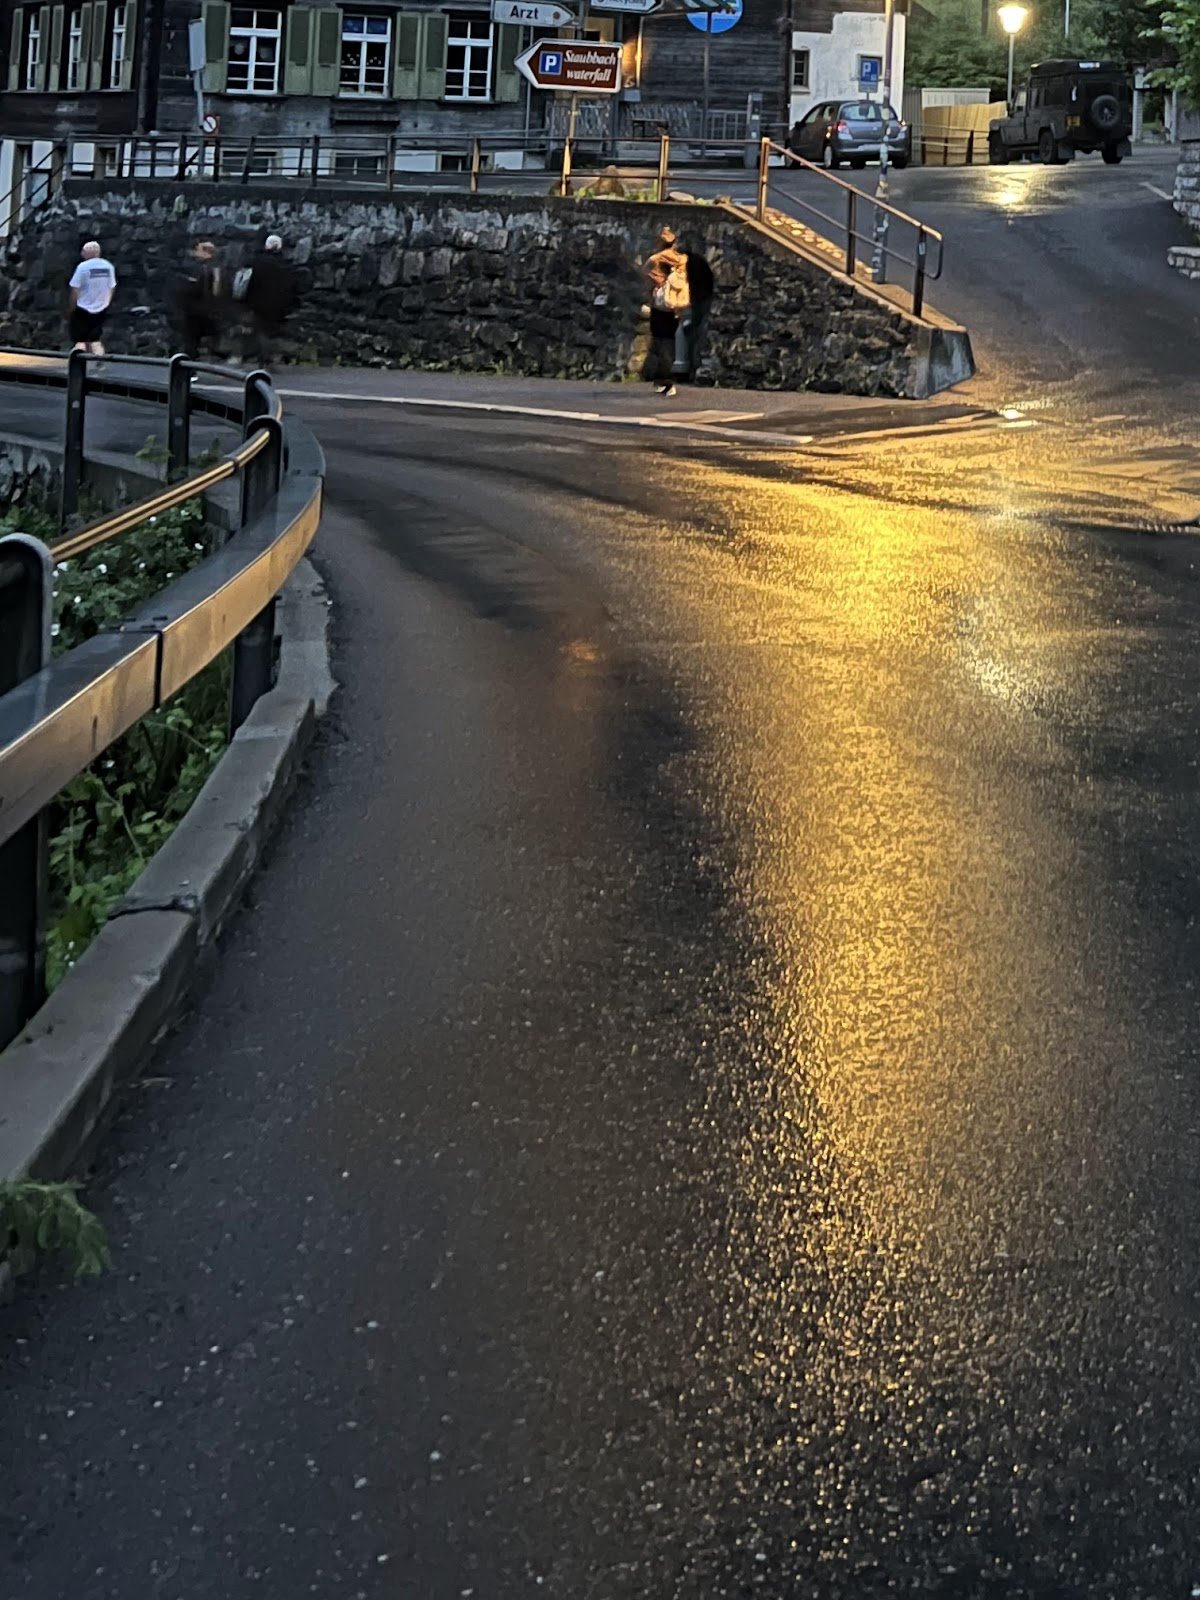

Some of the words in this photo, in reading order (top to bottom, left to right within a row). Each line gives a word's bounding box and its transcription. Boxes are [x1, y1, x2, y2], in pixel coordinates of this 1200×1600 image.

[510, 5, 538, 19] Arzt
[545, 55, 557, 72] P
[564, 50, 616, 65] Staubbach
[567, 68, 612, 84] waterfall
[862, 62, 872, 77] P
